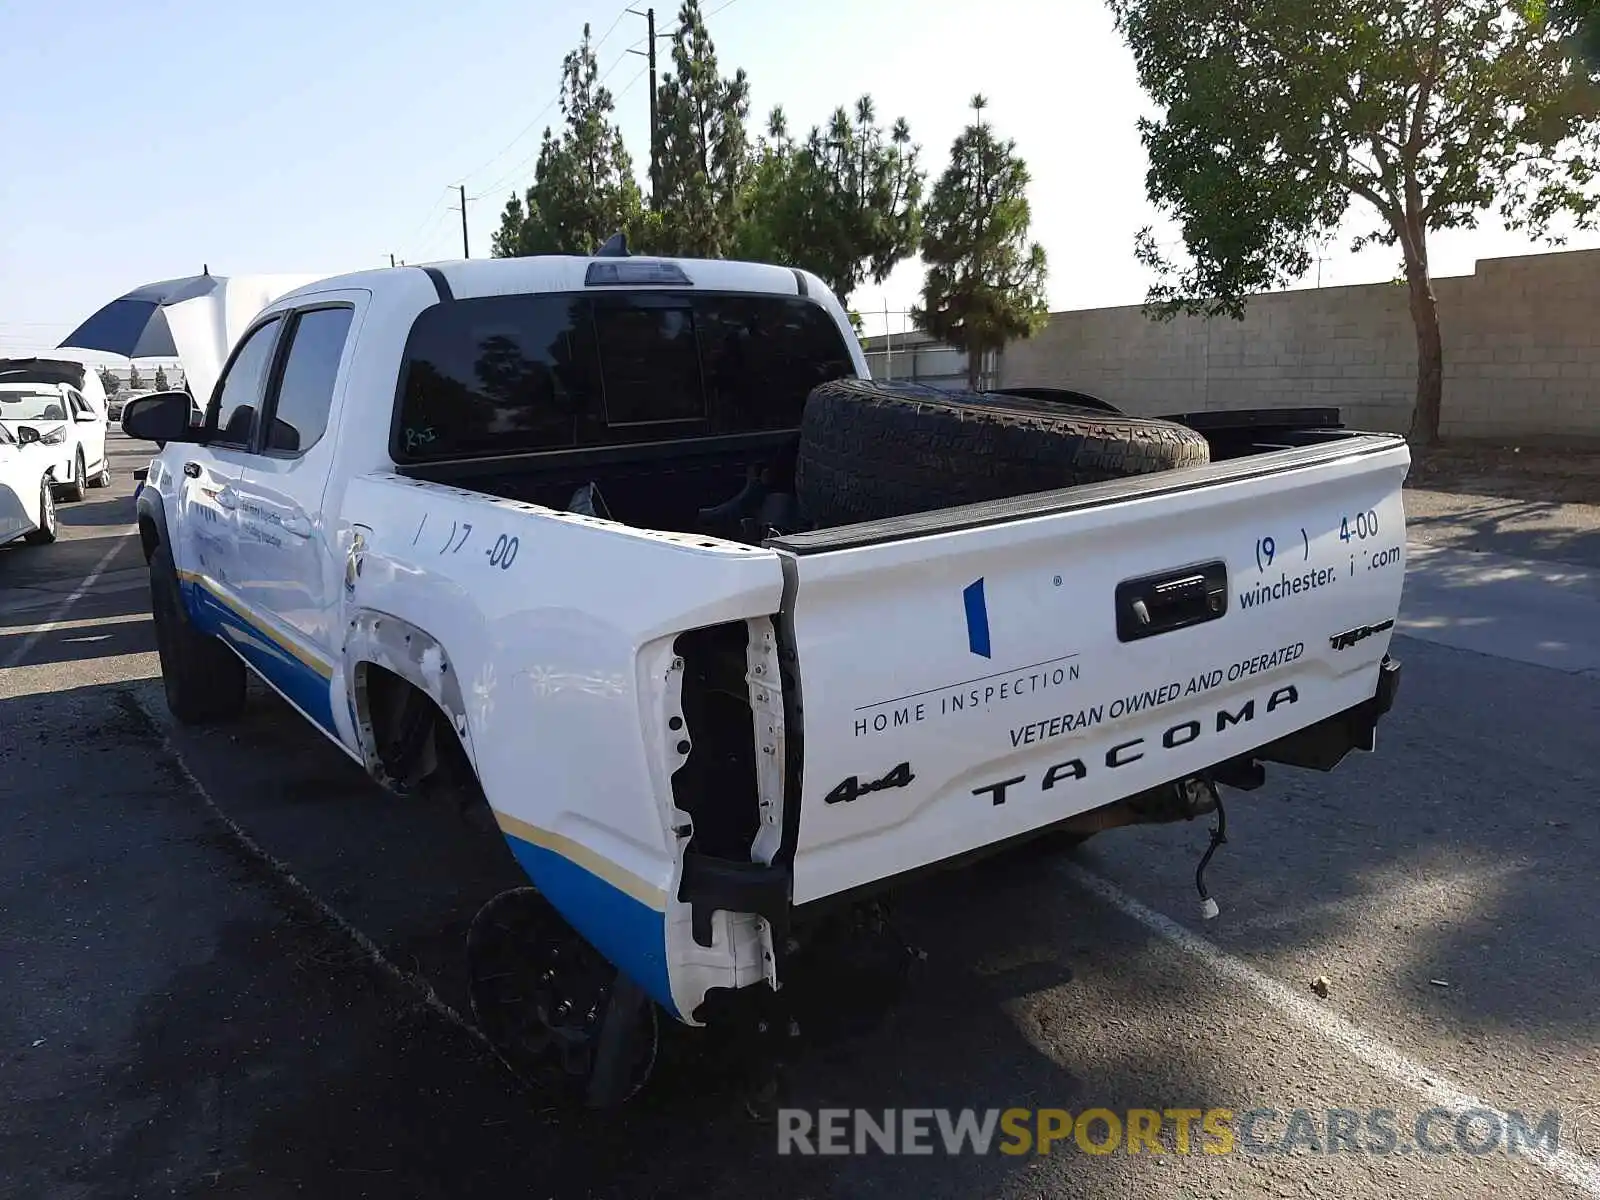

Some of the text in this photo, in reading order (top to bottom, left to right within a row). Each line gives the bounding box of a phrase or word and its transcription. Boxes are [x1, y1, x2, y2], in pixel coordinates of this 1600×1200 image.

[854, 663, 1081, 737] HOME INSPECTION
[1009, 642, 1305, 748] VETERAN OWNED AND OPERATED
[824, 761, 916, 804] 4x4
[971, 685, 1300, 807] TACOMA
